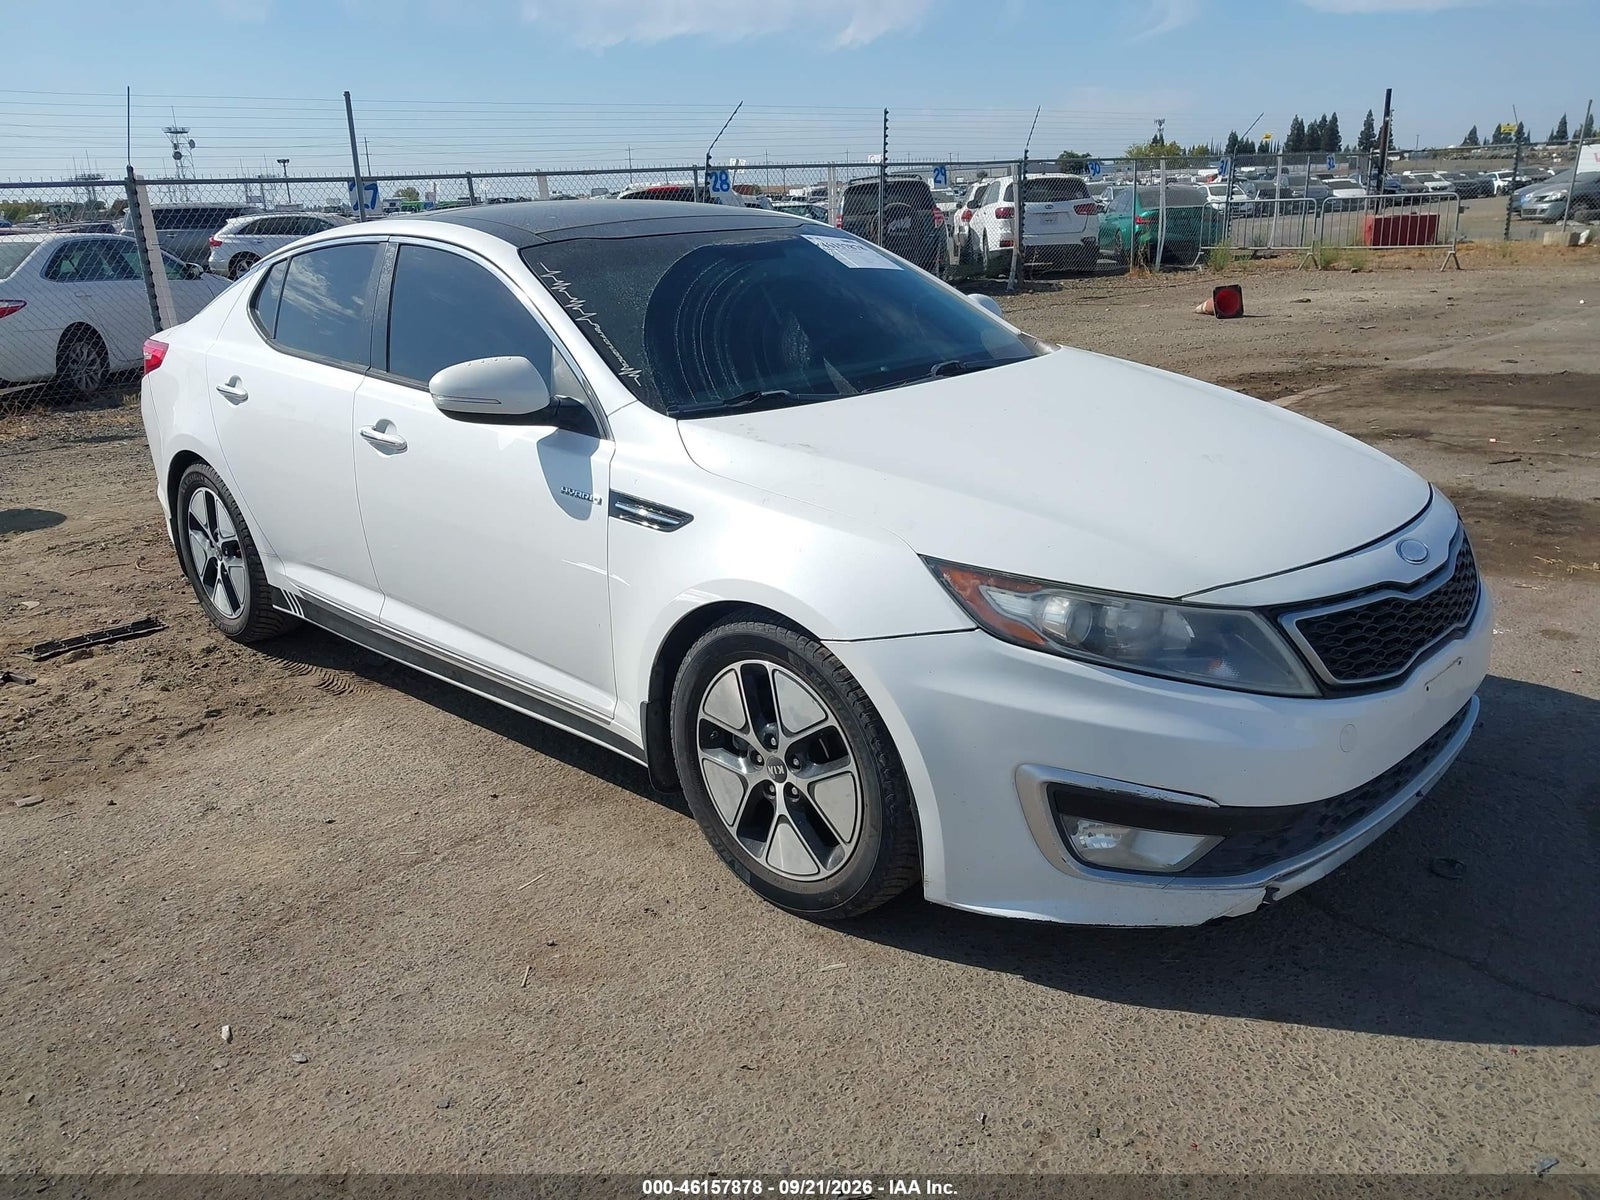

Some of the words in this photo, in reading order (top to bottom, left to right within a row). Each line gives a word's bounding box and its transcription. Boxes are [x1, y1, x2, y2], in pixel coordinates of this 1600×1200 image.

[933, 165, 947, 185] 29
[1088, 162, 1101, 176] 30
[709, 170, 730, 192] 28
[767, 765, 785, 775] KIA
